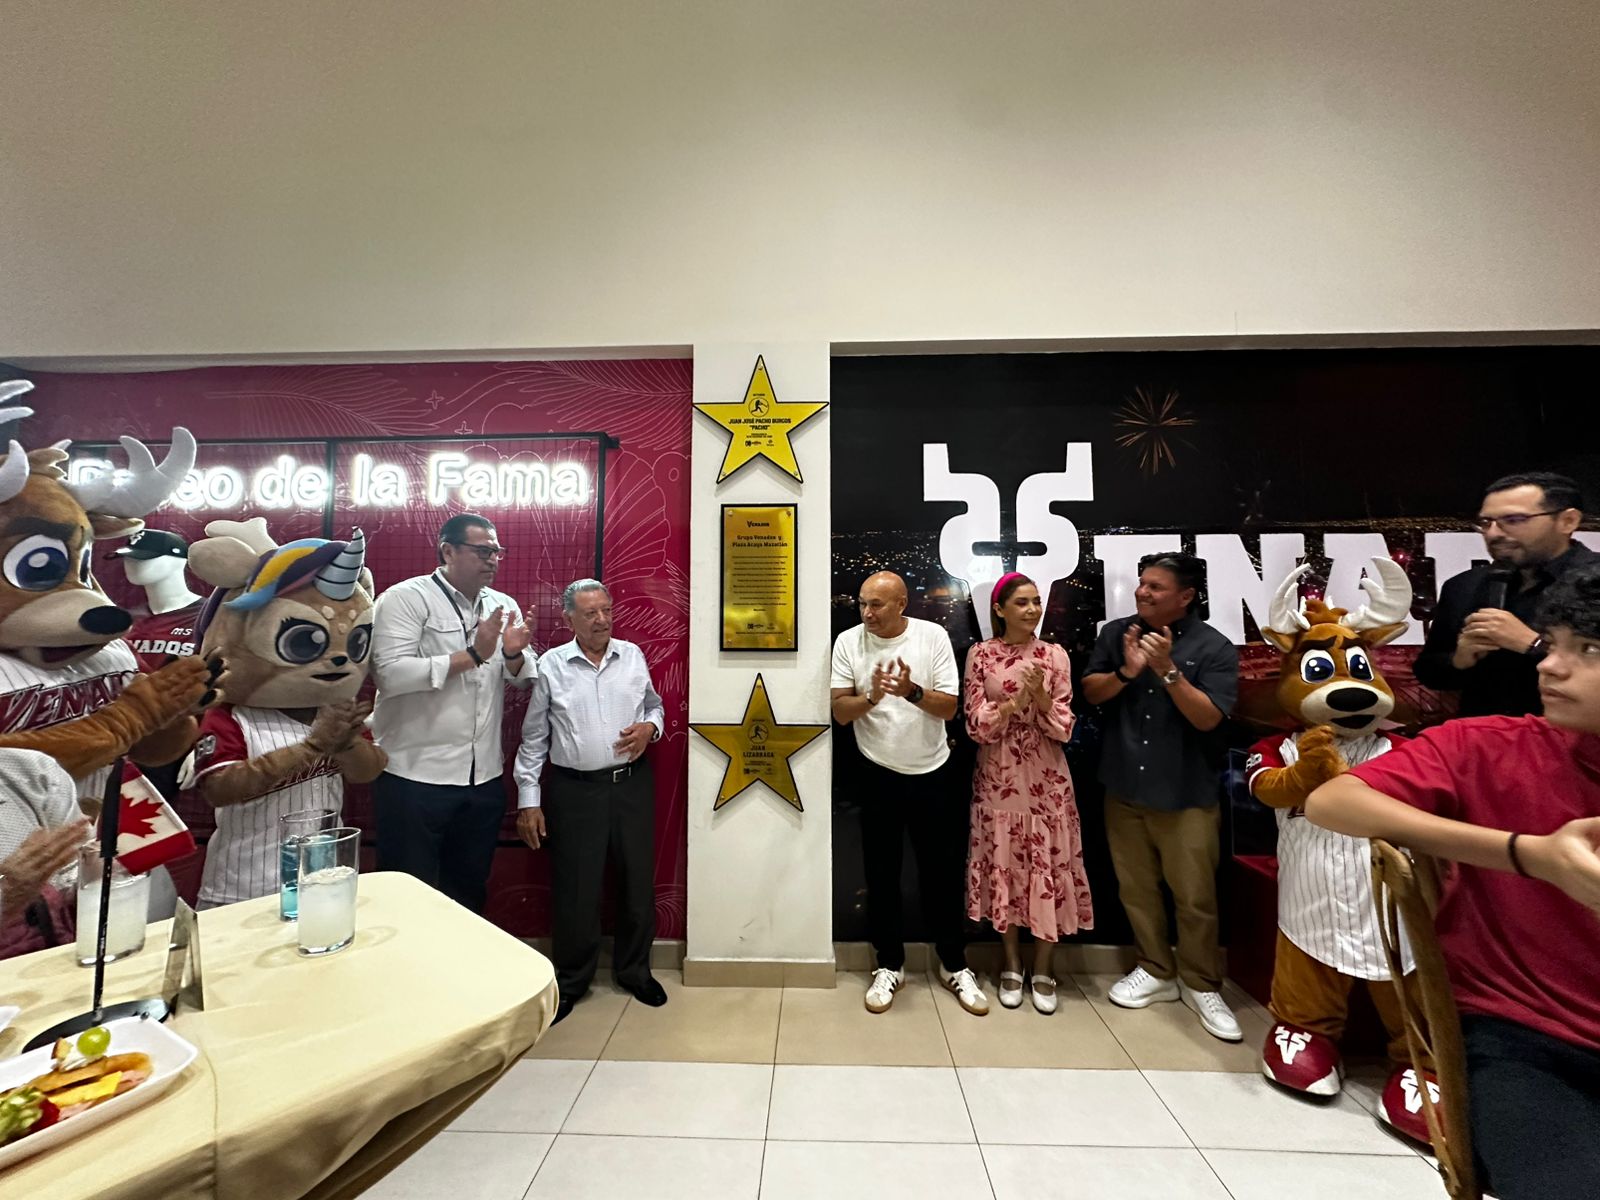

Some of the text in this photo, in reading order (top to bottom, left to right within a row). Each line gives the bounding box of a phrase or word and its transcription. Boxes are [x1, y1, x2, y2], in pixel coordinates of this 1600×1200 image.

[254, 454, 329, 508] de
[353, 453, 406, 506] la
[428, 451, 591, 507] Fama
